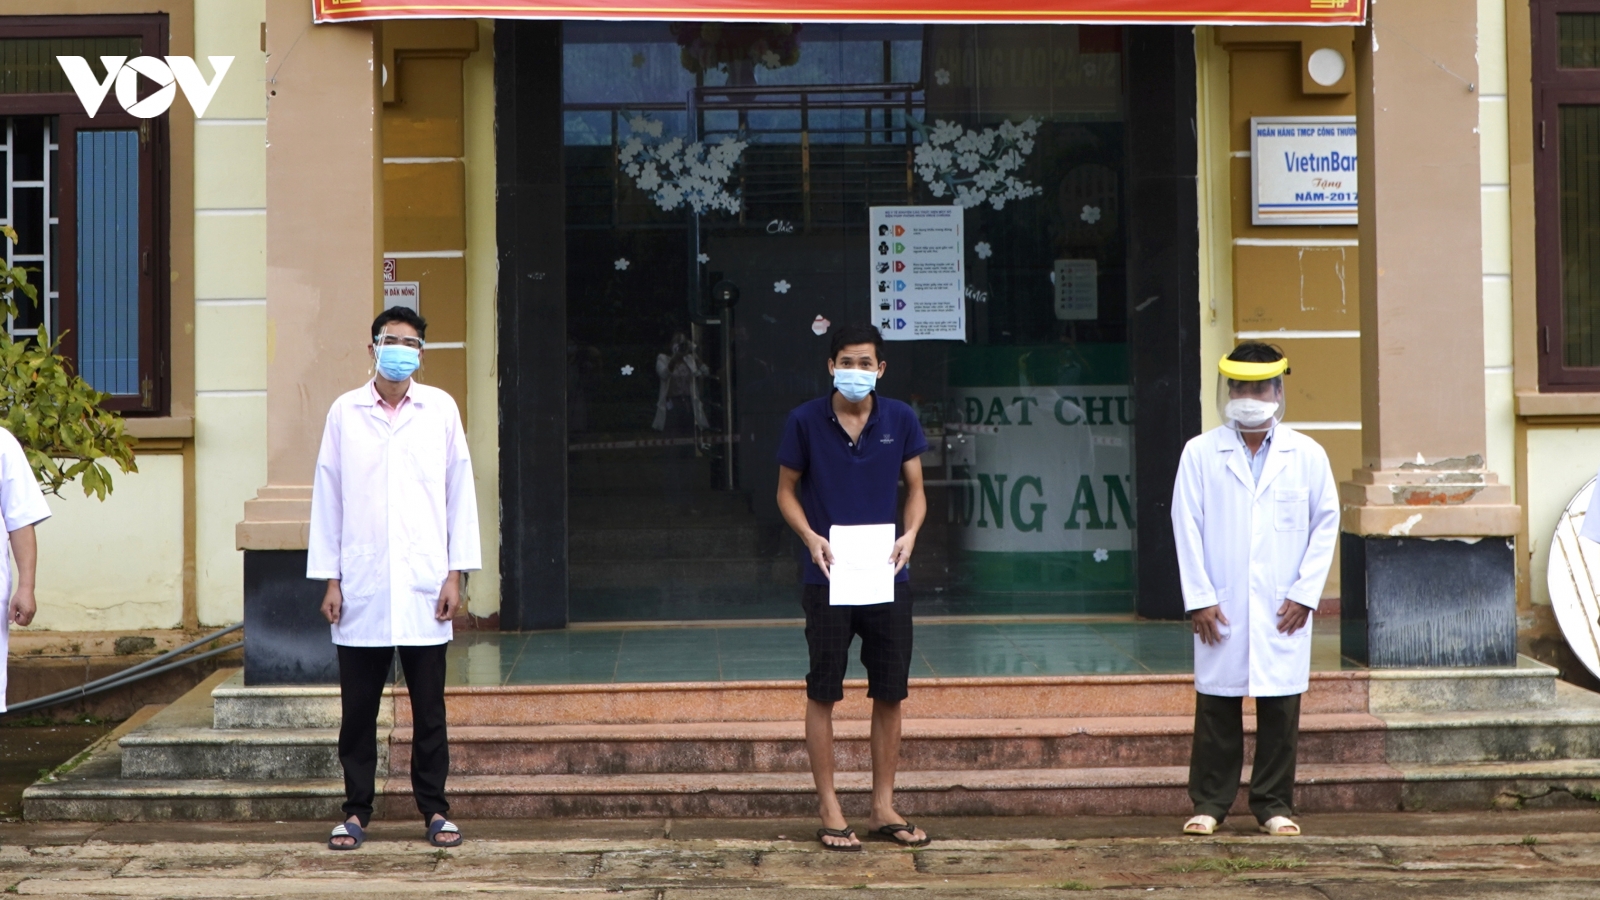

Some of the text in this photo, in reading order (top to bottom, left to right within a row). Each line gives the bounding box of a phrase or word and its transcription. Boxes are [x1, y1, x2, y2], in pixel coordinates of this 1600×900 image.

[1257, 127, 1276, 137] NGÂN
[1277, 126, 1295, 137] HÀNG
[1297, 128, 1315, 137] TMCP
[1317, 126, 1335, 137] CÔNG
[1312, 178, 1342, 190] Tặng
